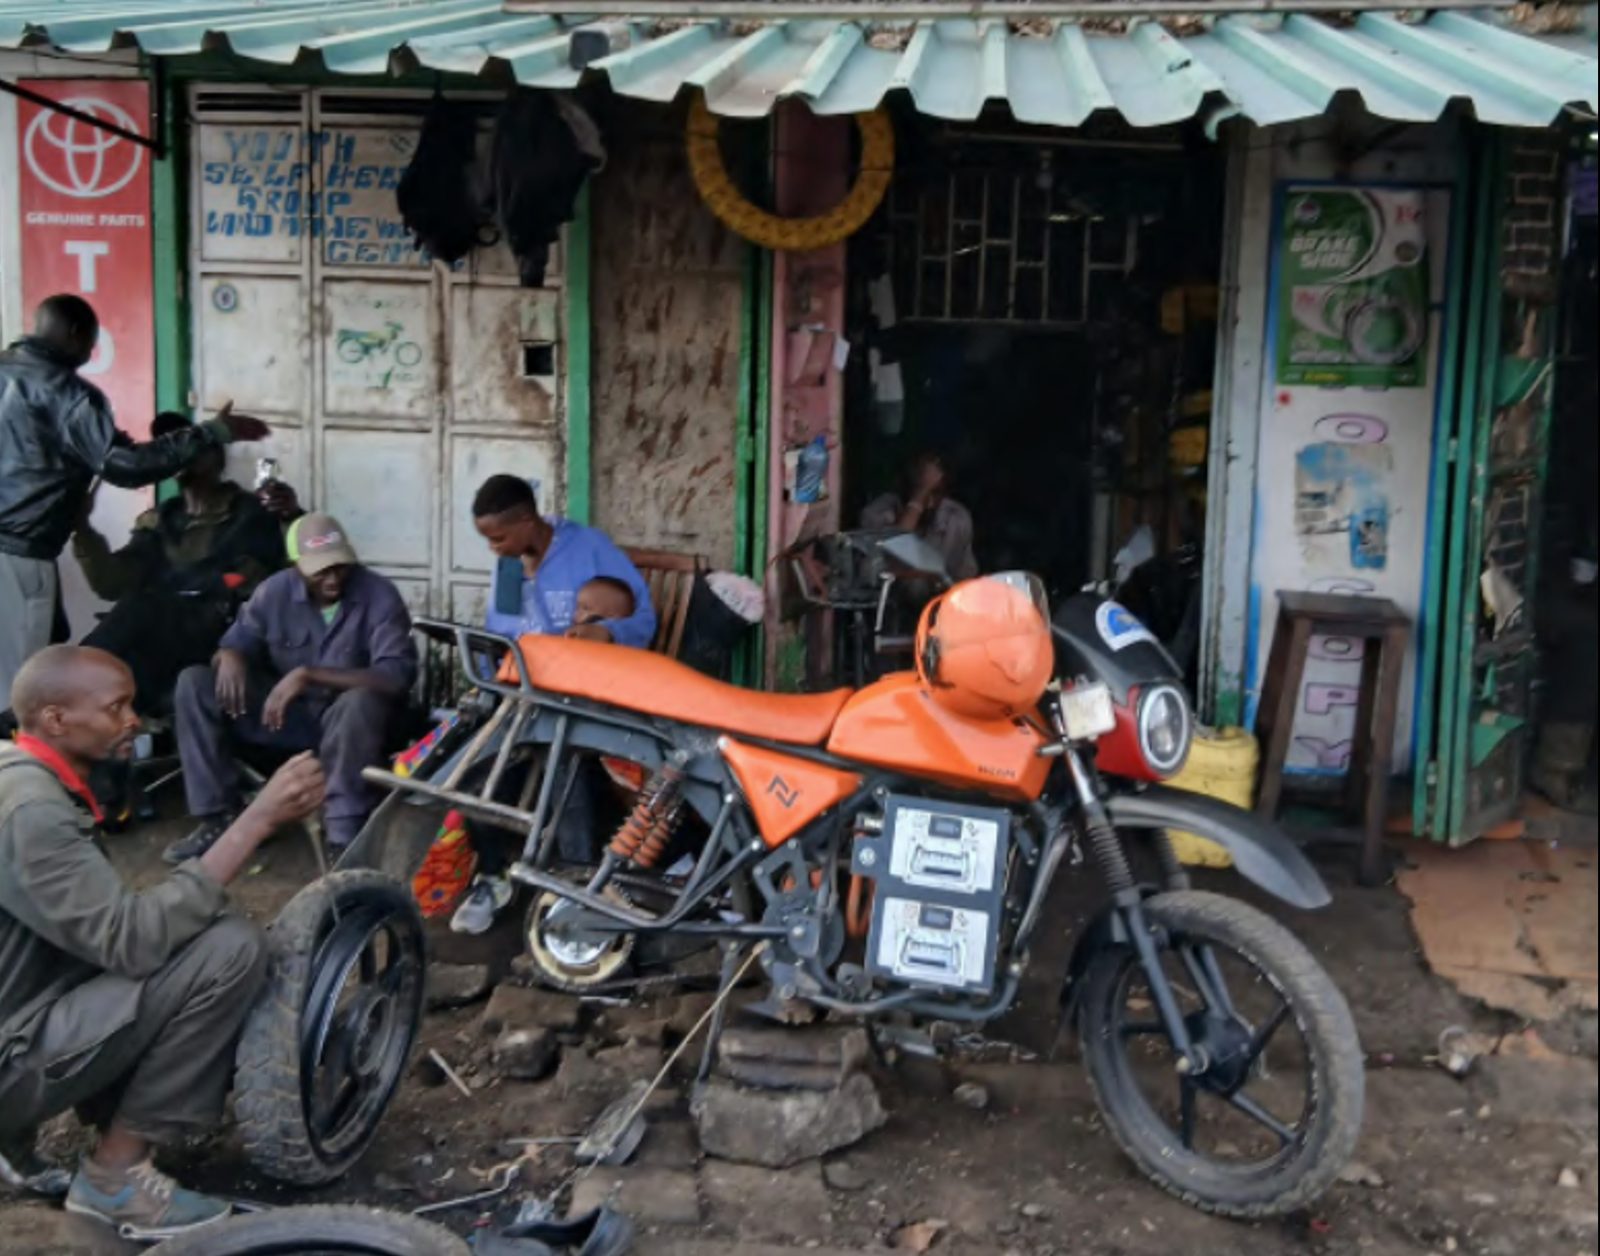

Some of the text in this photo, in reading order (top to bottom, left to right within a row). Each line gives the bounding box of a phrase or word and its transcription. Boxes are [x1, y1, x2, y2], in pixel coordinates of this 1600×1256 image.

[222, 131, 357, 163] YOUTH
[204, 162, 413, 190] SELF HEL
[236, 187, 352, 216] GROUP
[26, 211, 145, 228] GENUINE PARTS
